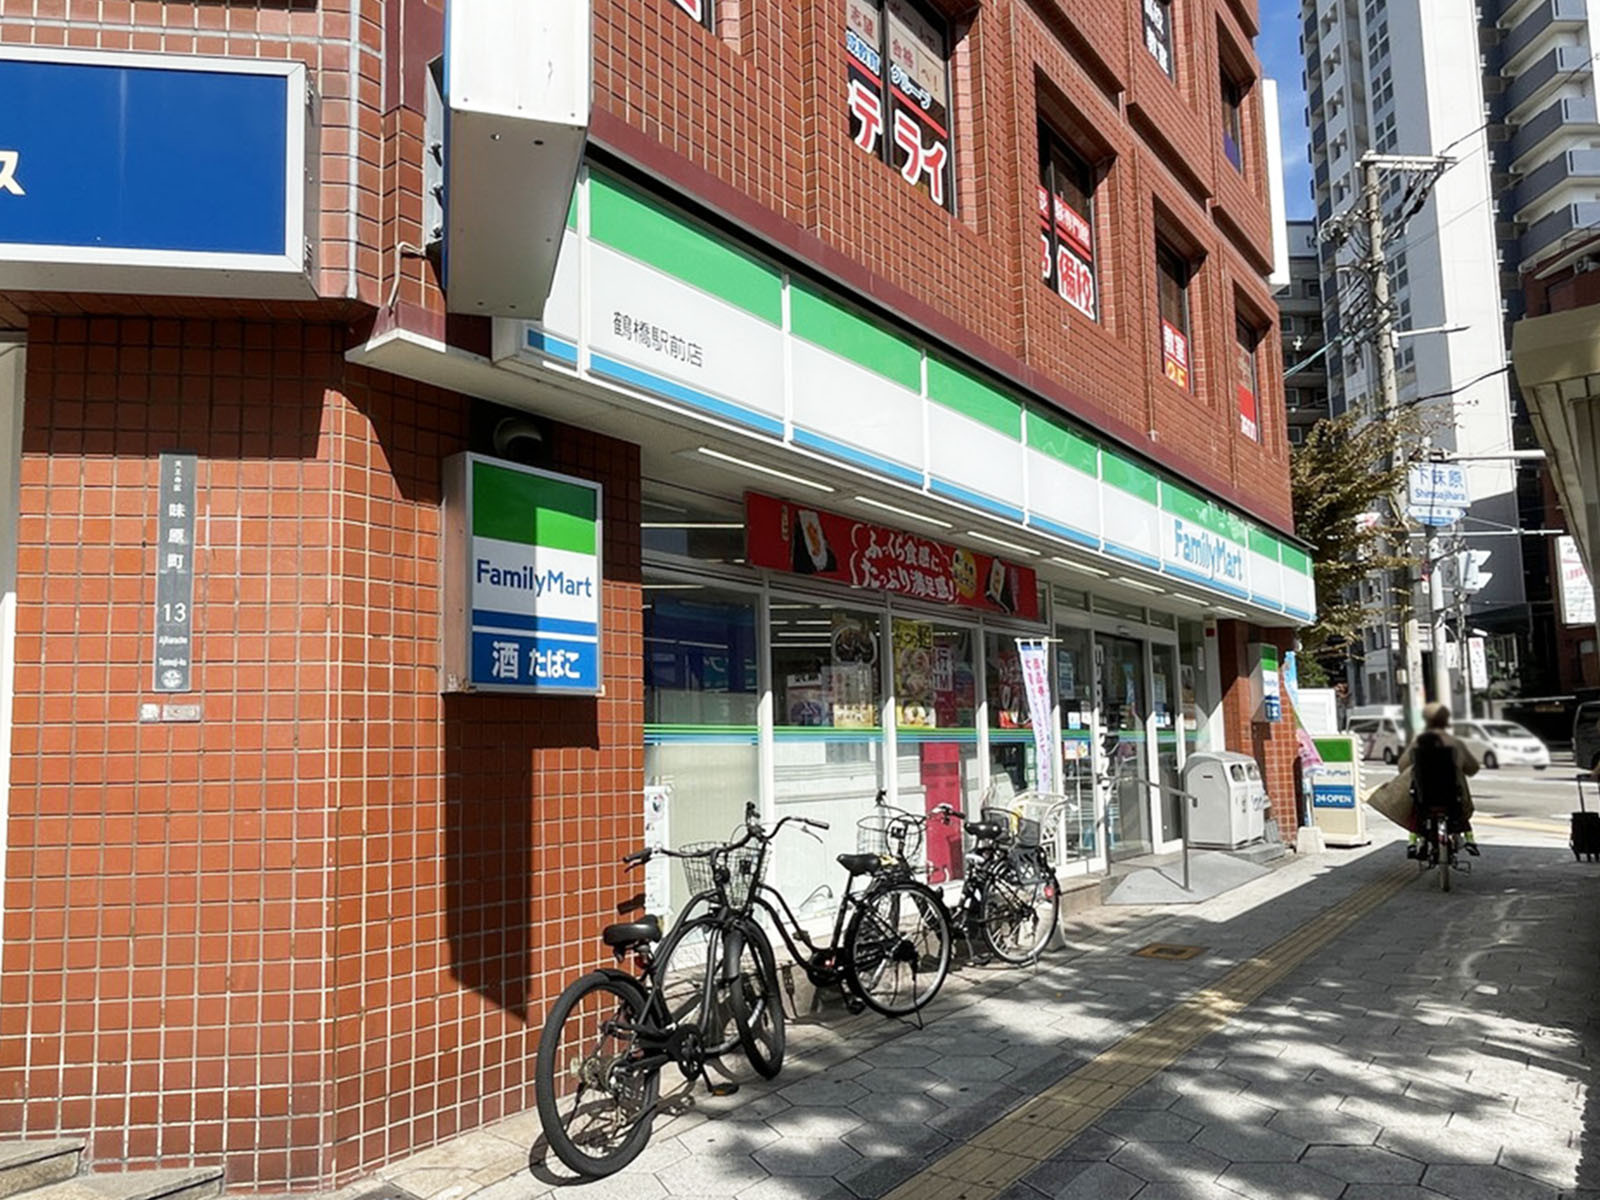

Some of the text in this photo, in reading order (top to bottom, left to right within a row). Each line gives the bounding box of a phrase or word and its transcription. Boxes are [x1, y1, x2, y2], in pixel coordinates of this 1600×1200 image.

[613, 311, 702, 367] 鶴橋駅前店
[1418, 465, 1462, 488] 下味原
[167, 502, 186, 569] 味原町
[1174, 518, 1243, 581] FamilyMart
[477, 558, 592, 598] FamilyMart
[163, 602, 186, 623] 13
[491, 640, 581, 680] 酒 たばこ
